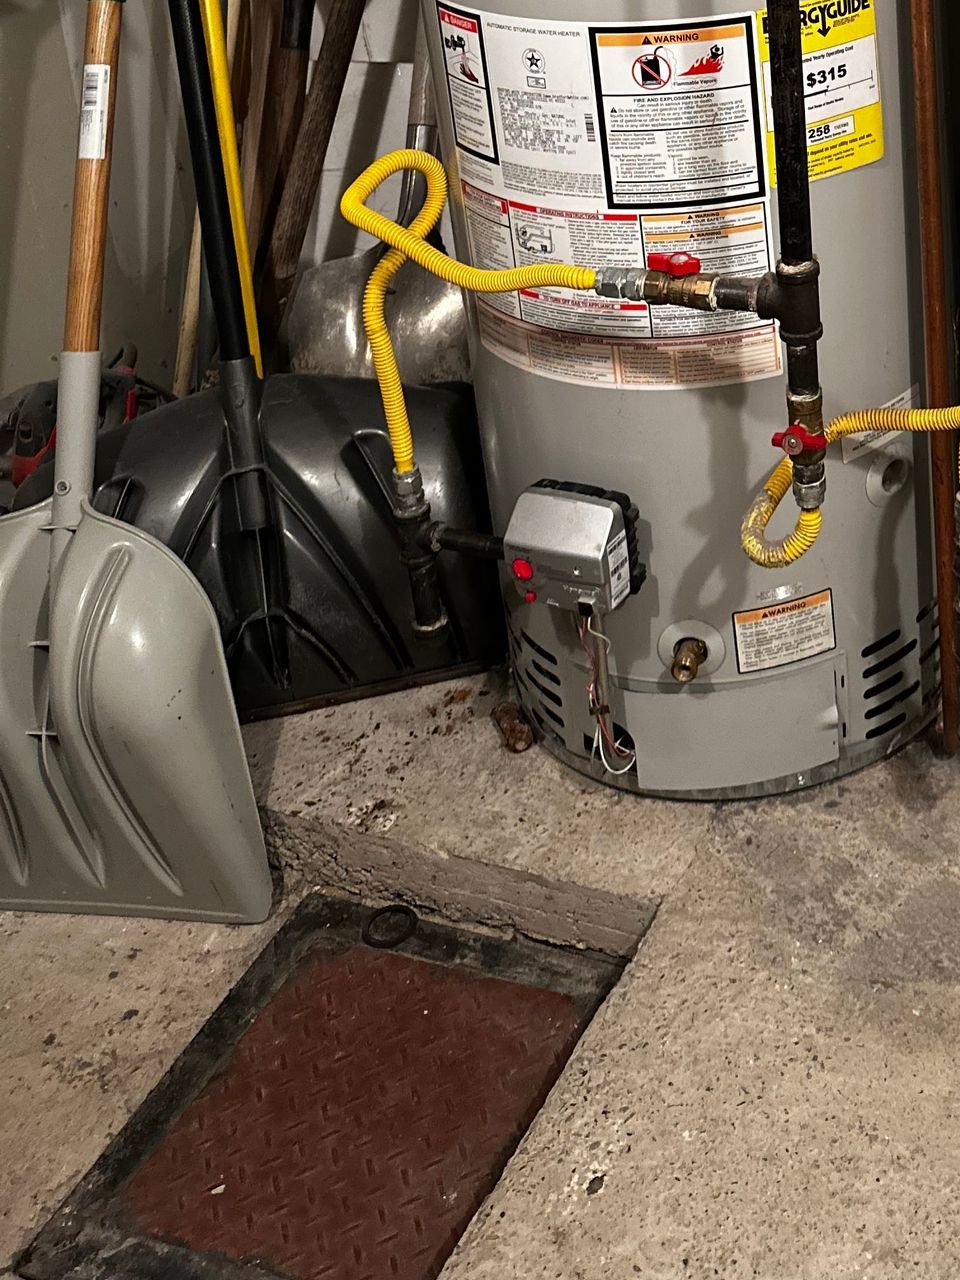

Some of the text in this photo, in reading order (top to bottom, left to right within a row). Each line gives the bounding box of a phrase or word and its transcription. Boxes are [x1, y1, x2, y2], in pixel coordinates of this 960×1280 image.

[487, 22, 512, 32] AUTOMATIC
[654, 33, 699, 43] WARNING
[807, 64, 847, 88] $315
[808, 125, 830, 139] 258
[768, 601, 806, 617] WARNING
